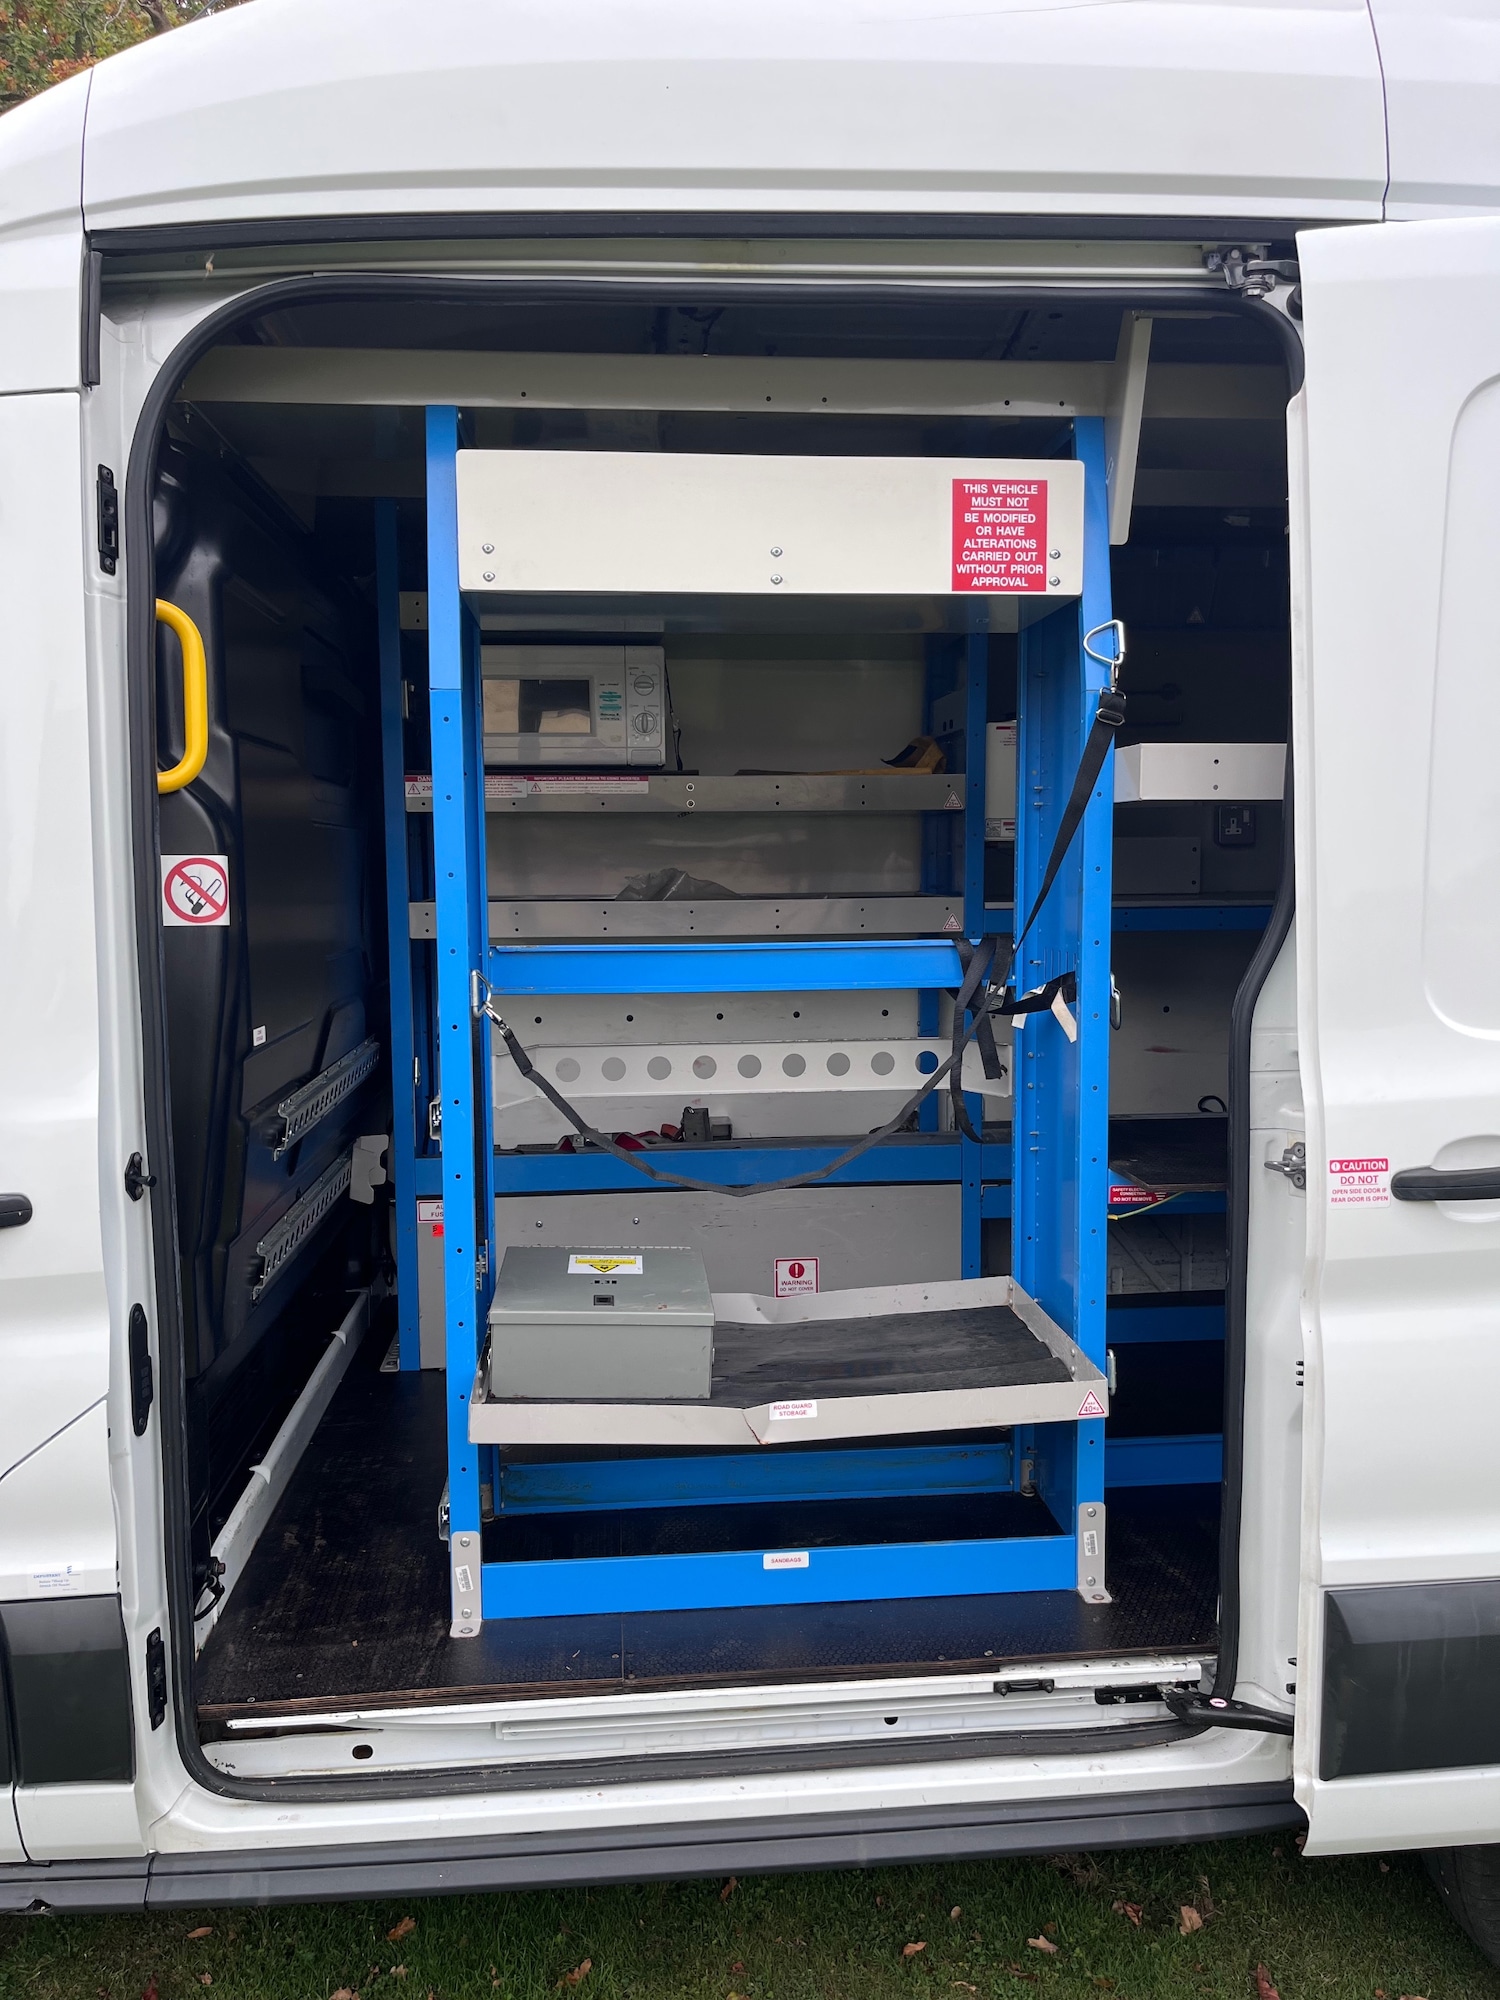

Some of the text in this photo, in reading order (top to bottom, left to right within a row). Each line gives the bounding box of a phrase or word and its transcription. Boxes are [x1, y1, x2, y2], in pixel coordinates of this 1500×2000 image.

[963, 484, 1038, 494] THIS VEHICLE
[972, 497, 1029, 507] MUST NOT
[964, 513, 1036, 523] BE MODIFIED
[976, 526, 1025, 536] OR HAVE
[964, 539, 1037, 548] ALTERATIONS
[962, 552, 1037, 561] CARRIED OUT
[956, 564, 1043, 574] WITHOUT PRIOR
[971, 577, 1028, 586] APPROVAL
[1342, 1161, 1386, 1171] CAUTION
[1340, 1175, 1378, 1184] DO NOT
